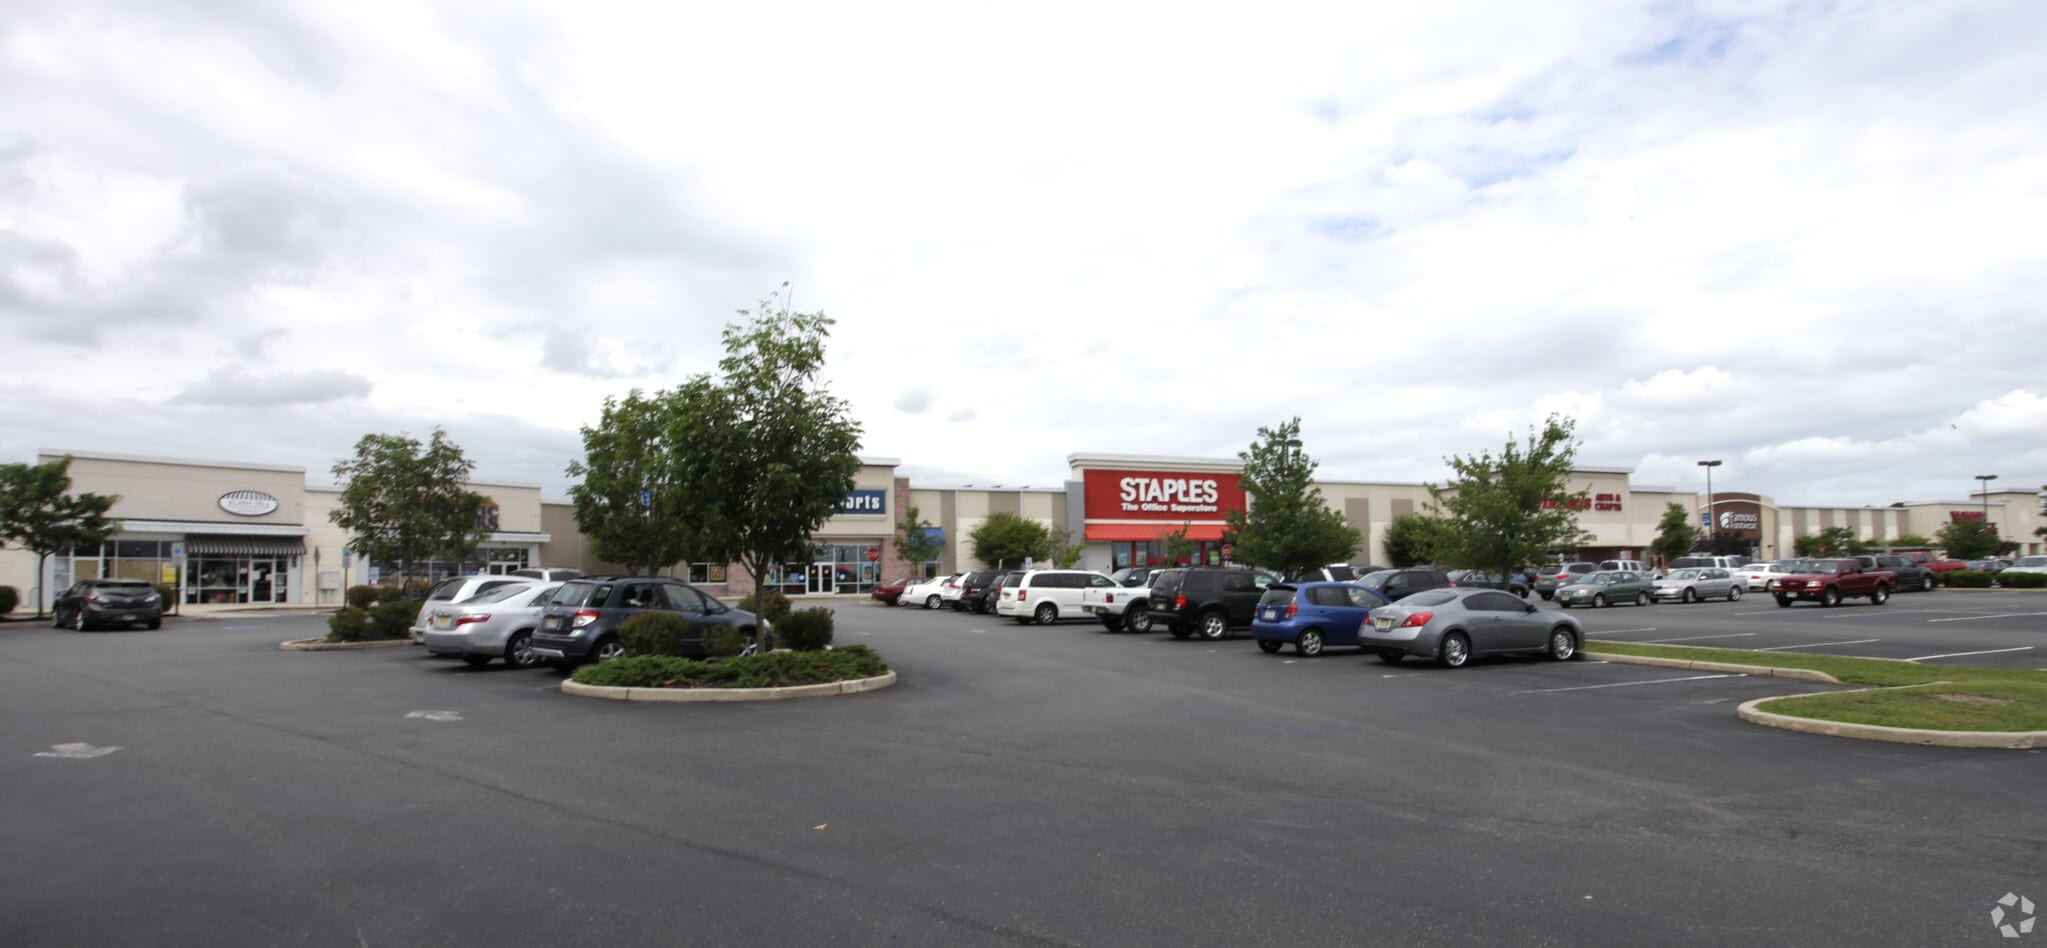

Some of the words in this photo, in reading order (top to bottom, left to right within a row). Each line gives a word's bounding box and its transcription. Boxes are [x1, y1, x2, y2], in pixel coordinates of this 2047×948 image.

[1120, 477, 1218, 503] STAPLES
[1121, 503, 1139, 511] The
[1141, 503, 1168, 511] Office
[1170, 504, 1217, 512] Superstore
